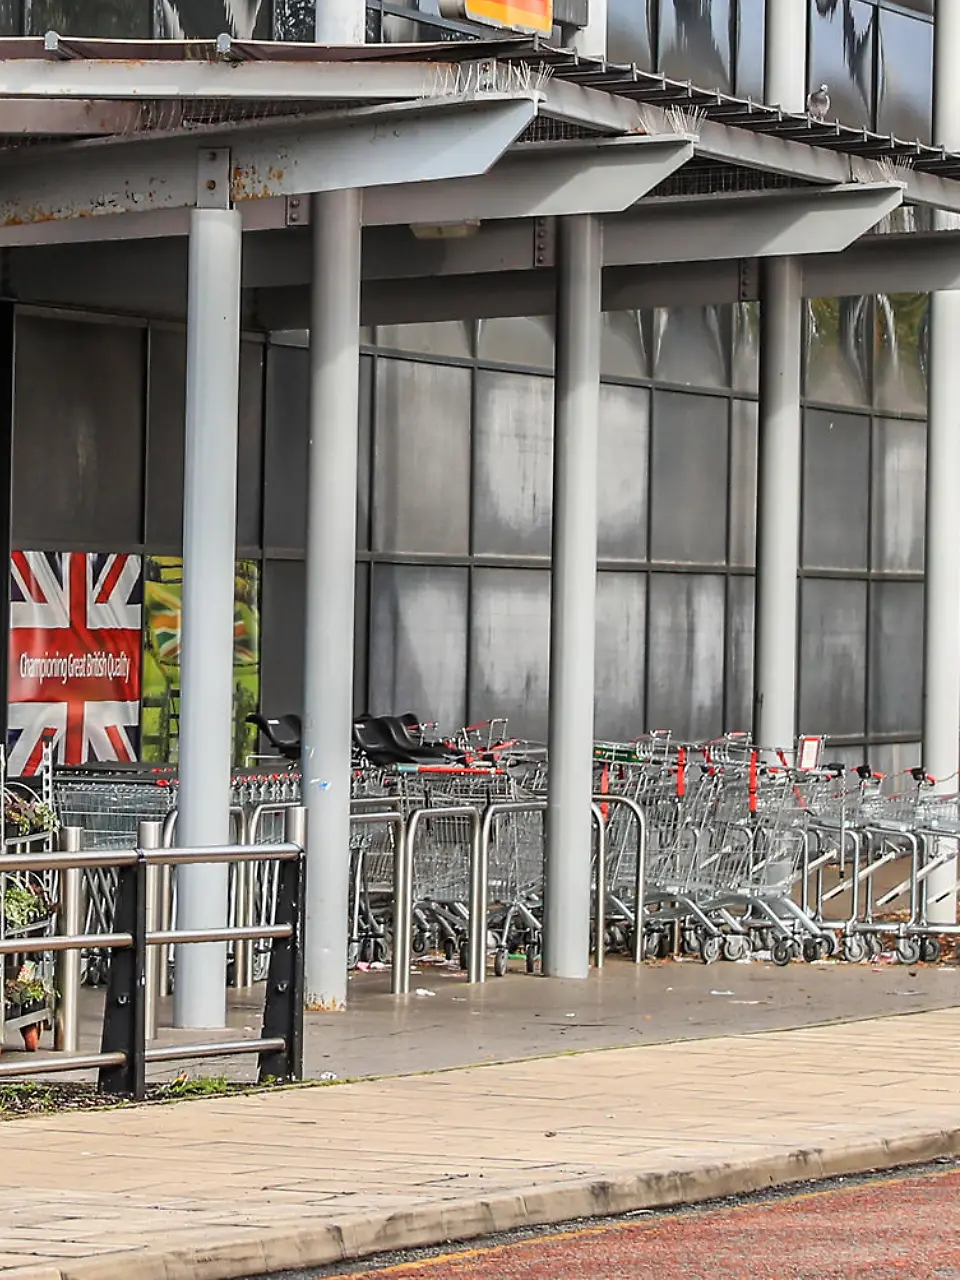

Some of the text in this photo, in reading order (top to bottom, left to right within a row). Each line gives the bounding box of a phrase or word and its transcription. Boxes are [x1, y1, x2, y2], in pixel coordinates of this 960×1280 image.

[20, 650, 131, 685] Championing Great British Quality
